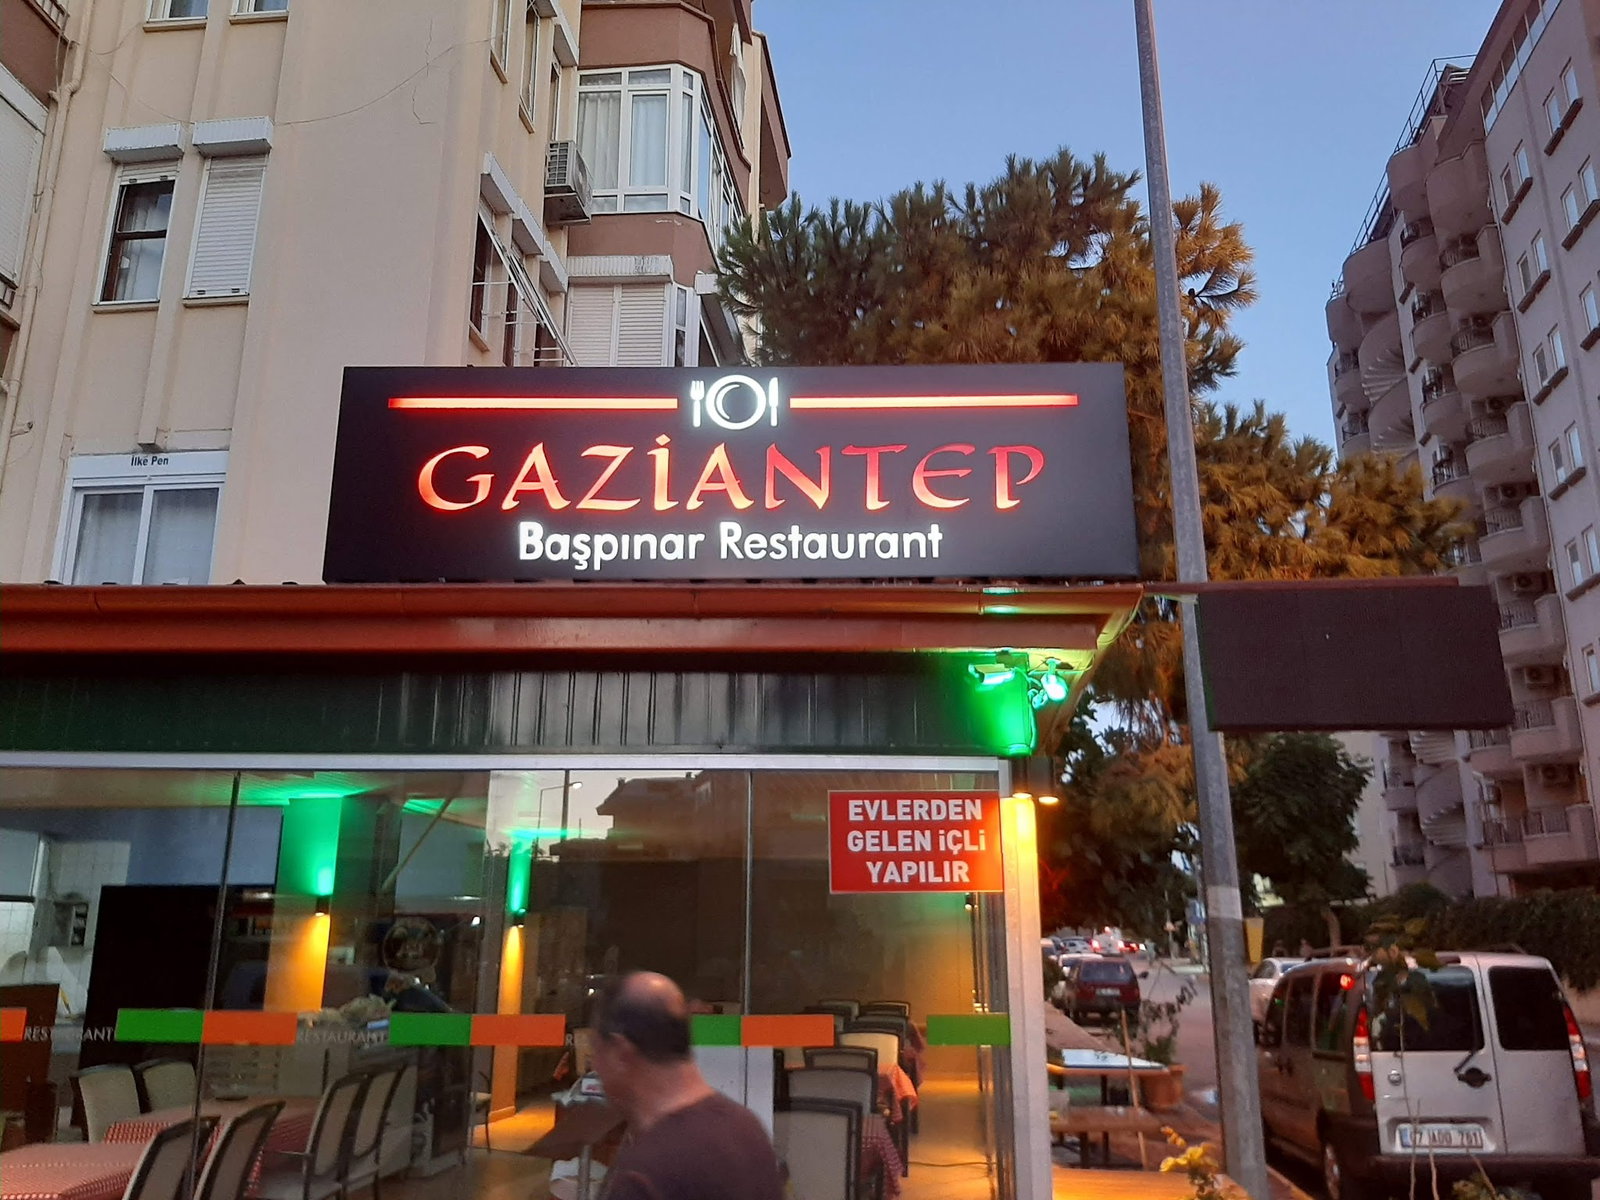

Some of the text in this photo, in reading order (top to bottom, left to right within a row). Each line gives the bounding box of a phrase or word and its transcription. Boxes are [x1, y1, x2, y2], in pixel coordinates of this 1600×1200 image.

[151, 456, 169, 466] Pen
[418, 434, 1044, 510] GAZİANTEP
[519, 521, 943, 570] Başpınar Restaurant
[848, 799, 982, 821] EVLERDEN
[847, 829, 931, 852] GELEN
[866, 860, 970, 884] YAPILIR
